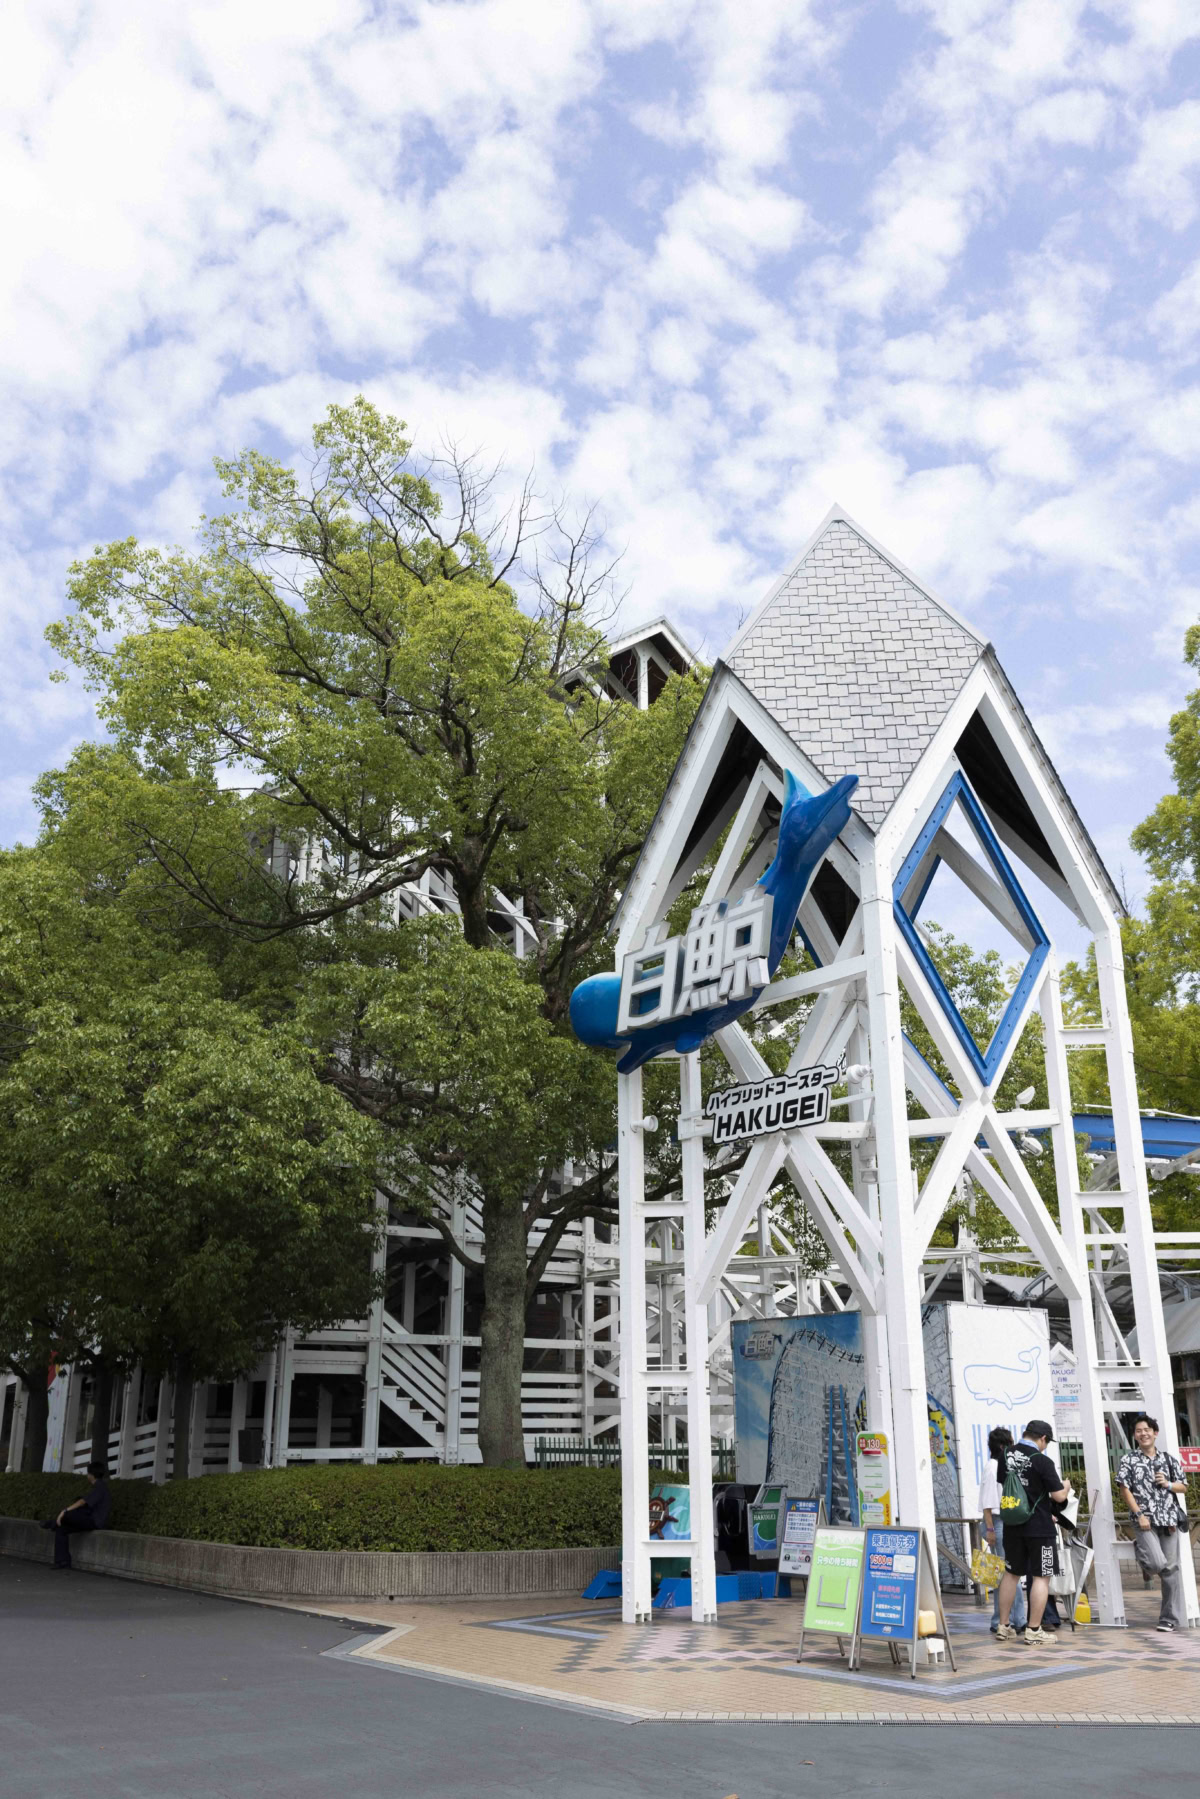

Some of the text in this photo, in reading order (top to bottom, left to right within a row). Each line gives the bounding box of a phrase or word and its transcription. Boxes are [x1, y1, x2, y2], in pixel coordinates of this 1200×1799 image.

[616, 888, 774, 1036] 白鯨
[709, 1070, 836, 1111] ハイブリッドコースター
[715, 1092, 824, 1139] HAKUGEI
[745, 1332, 775, 1358] 白鯨
[872, 1533, 916, 1549] 乗車優先券
[817, 1555, 859, 1568] 只今の待ち時間
